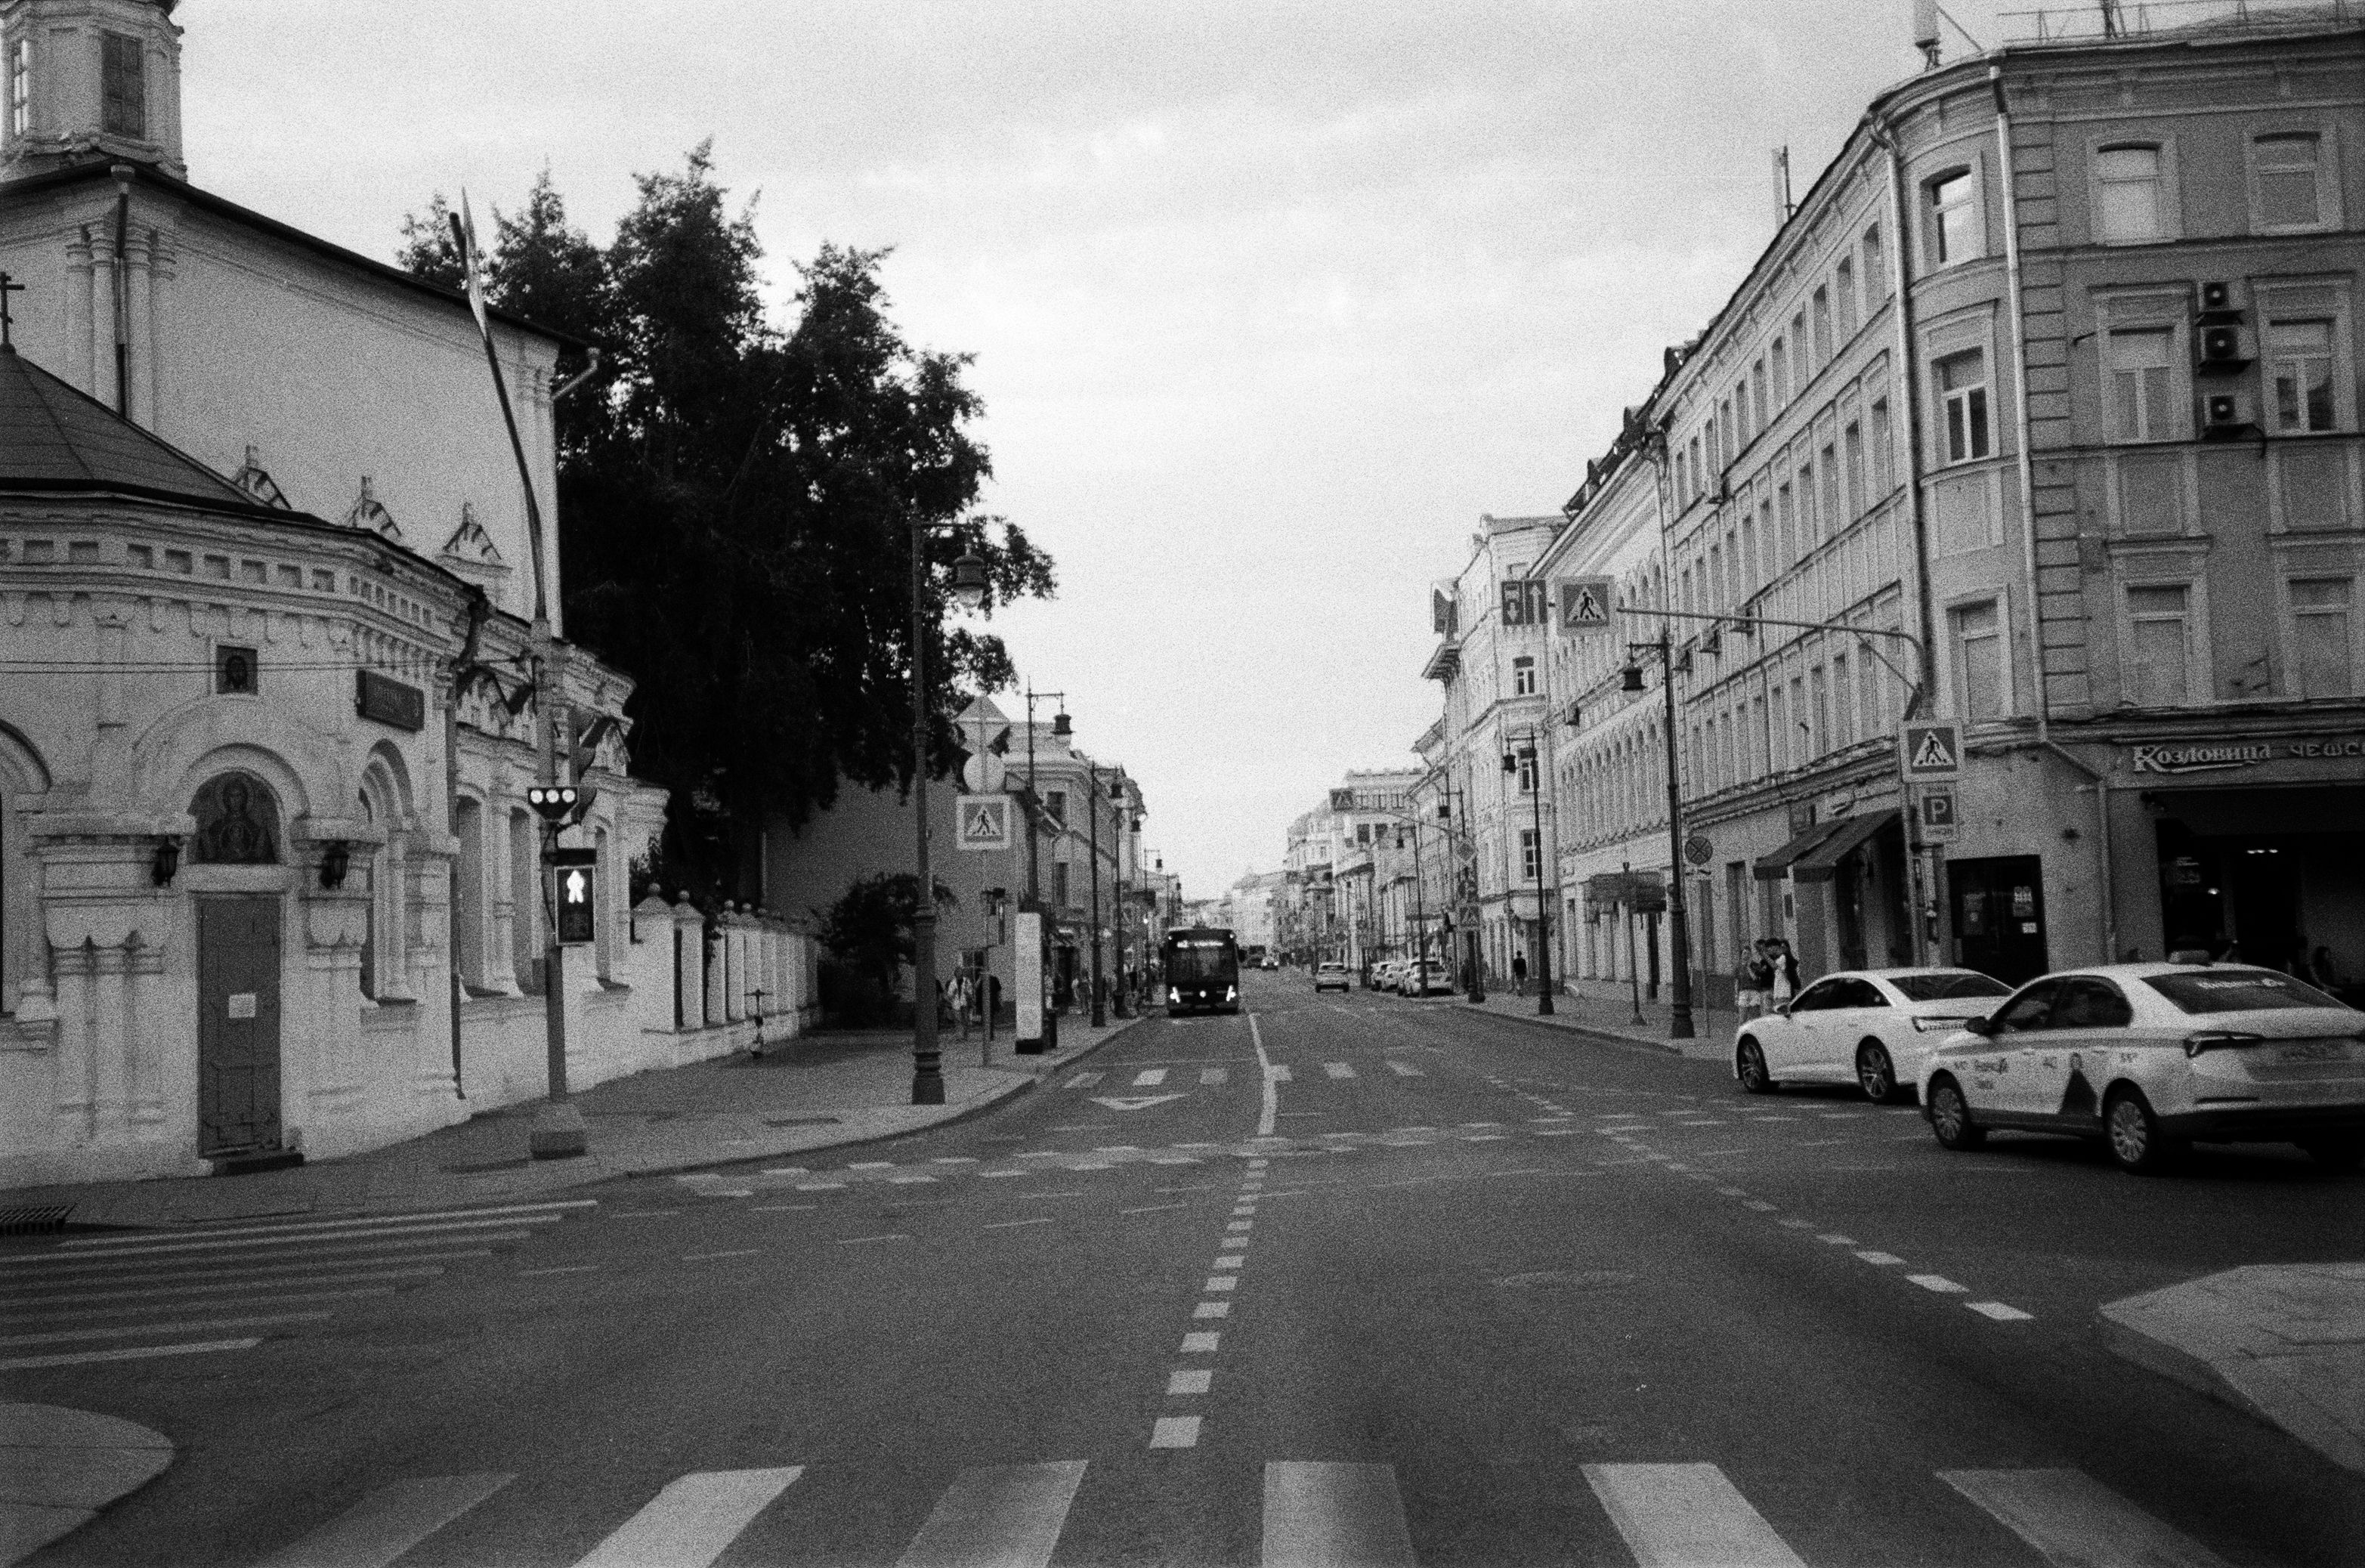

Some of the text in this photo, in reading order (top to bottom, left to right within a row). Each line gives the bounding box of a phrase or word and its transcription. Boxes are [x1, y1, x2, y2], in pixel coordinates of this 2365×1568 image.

[2133, 741, 2365, 772] Козловица ЧЕШС
[1931, 798, 1948, 823] P
